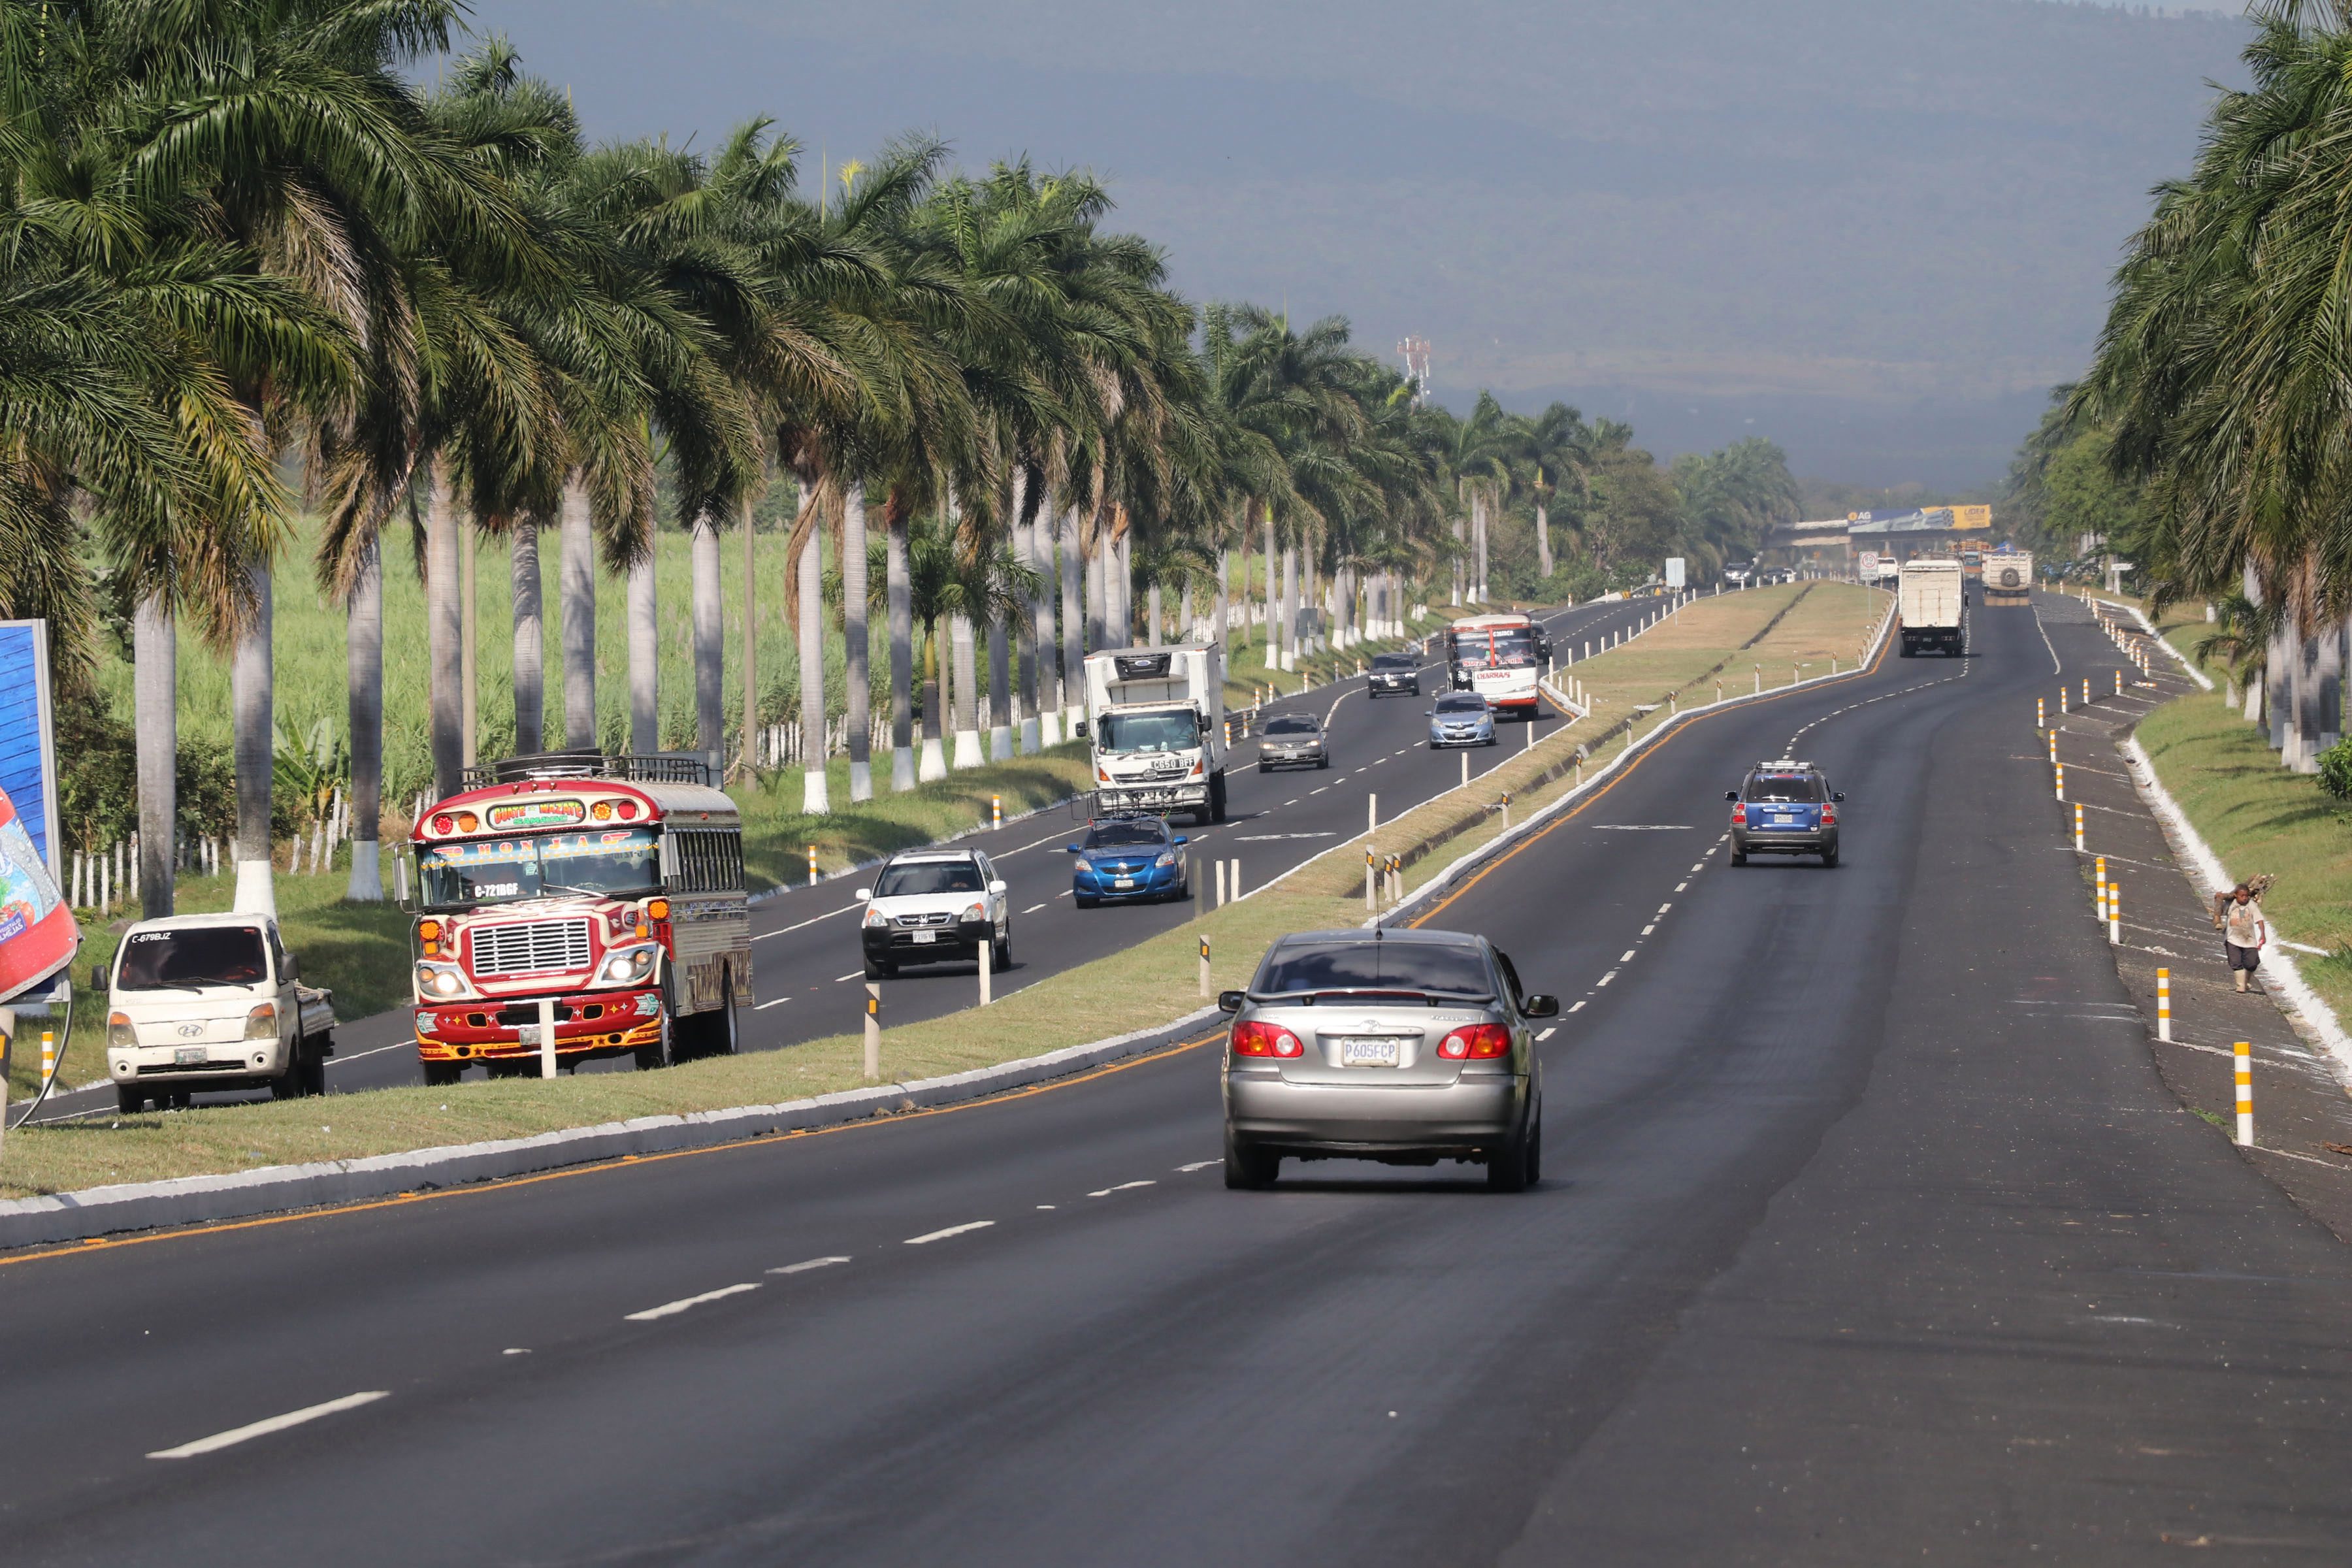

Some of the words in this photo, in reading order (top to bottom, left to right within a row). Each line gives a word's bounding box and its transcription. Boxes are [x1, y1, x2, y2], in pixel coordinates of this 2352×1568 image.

[1857, 512, 1871, 520] AG
[1154, 760, 1176, 769] C650
[1179, 758, 1194, 767] BFF
[494, 806, 526, 825] GUATE
[539, 801, 583, 819] MAZATE
[474, 882, 519, 898] C-721BGF
[0, 922, 24, 941] LMEJAS
[132, 932, 172, 943] C-679BJZ
